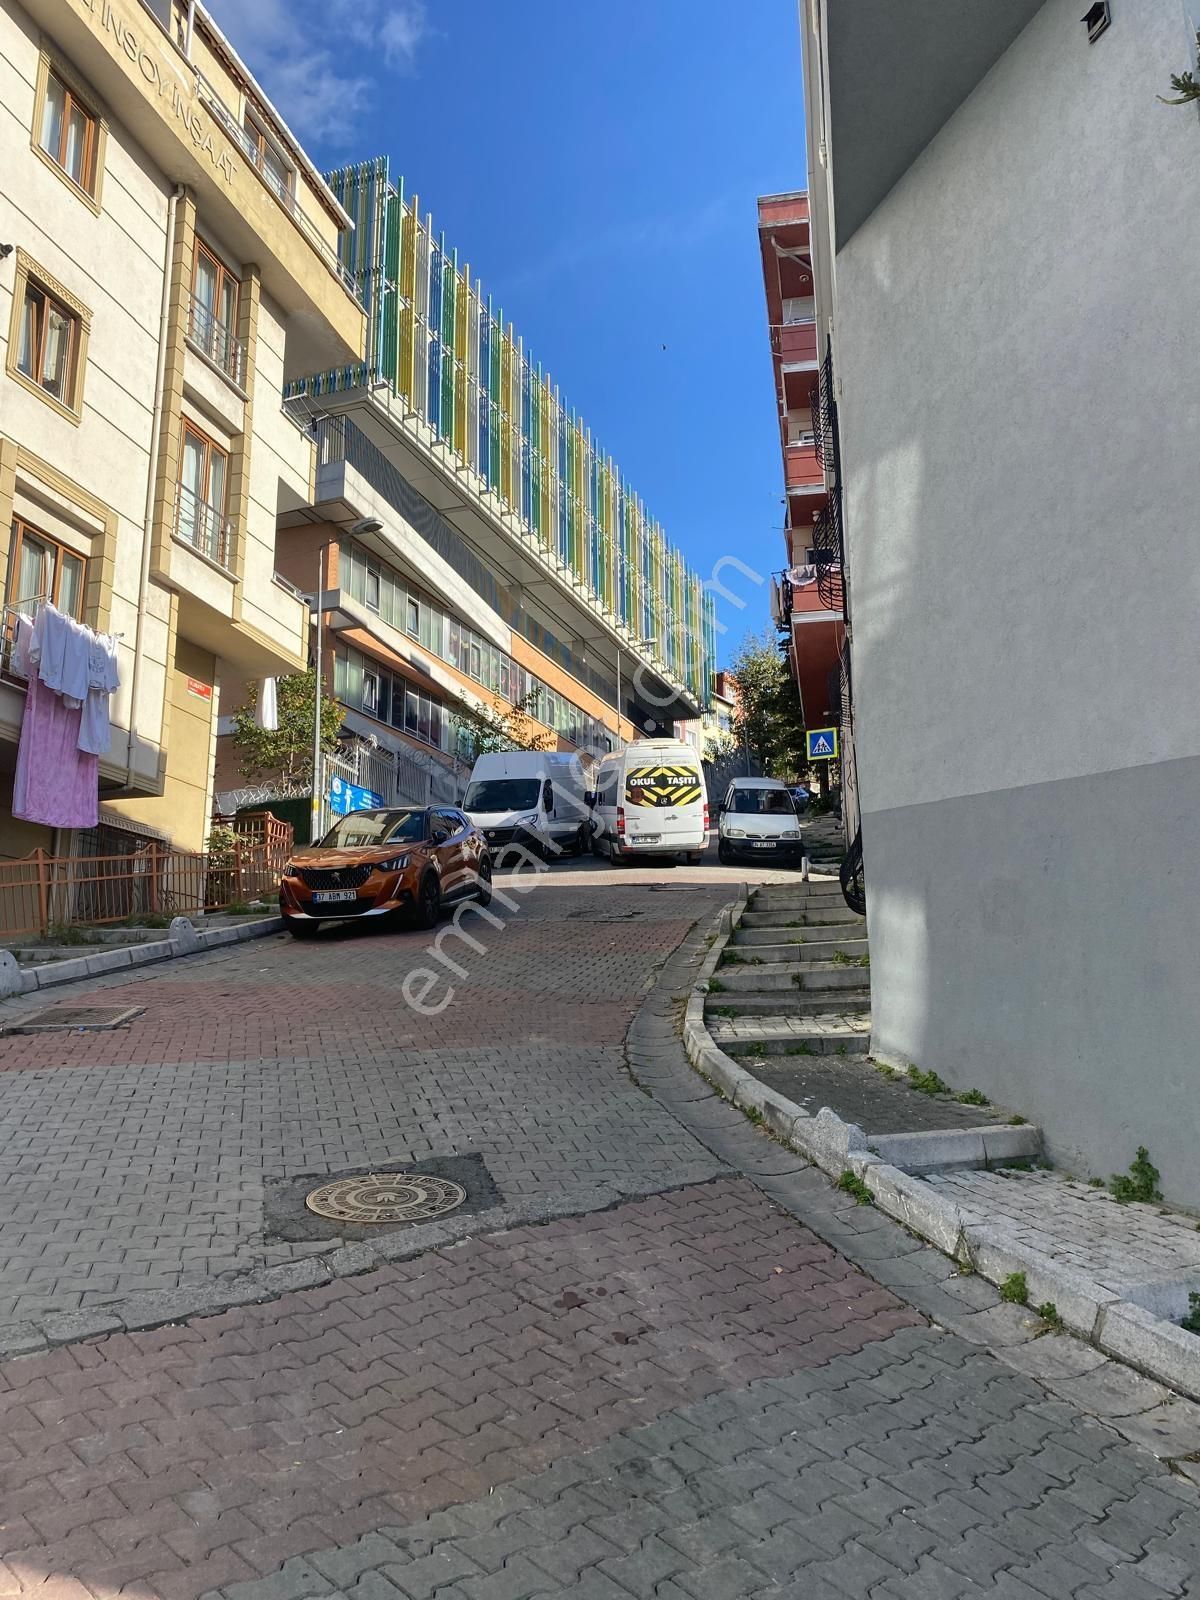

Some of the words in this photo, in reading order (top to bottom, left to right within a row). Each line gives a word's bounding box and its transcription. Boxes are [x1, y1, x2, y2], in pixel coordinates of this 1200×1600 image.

[171, 82, 238, 186] İNŞAAT
[630, 777, 656, 786] OKUL
[667, 776, 696, 786] TAŞITI
